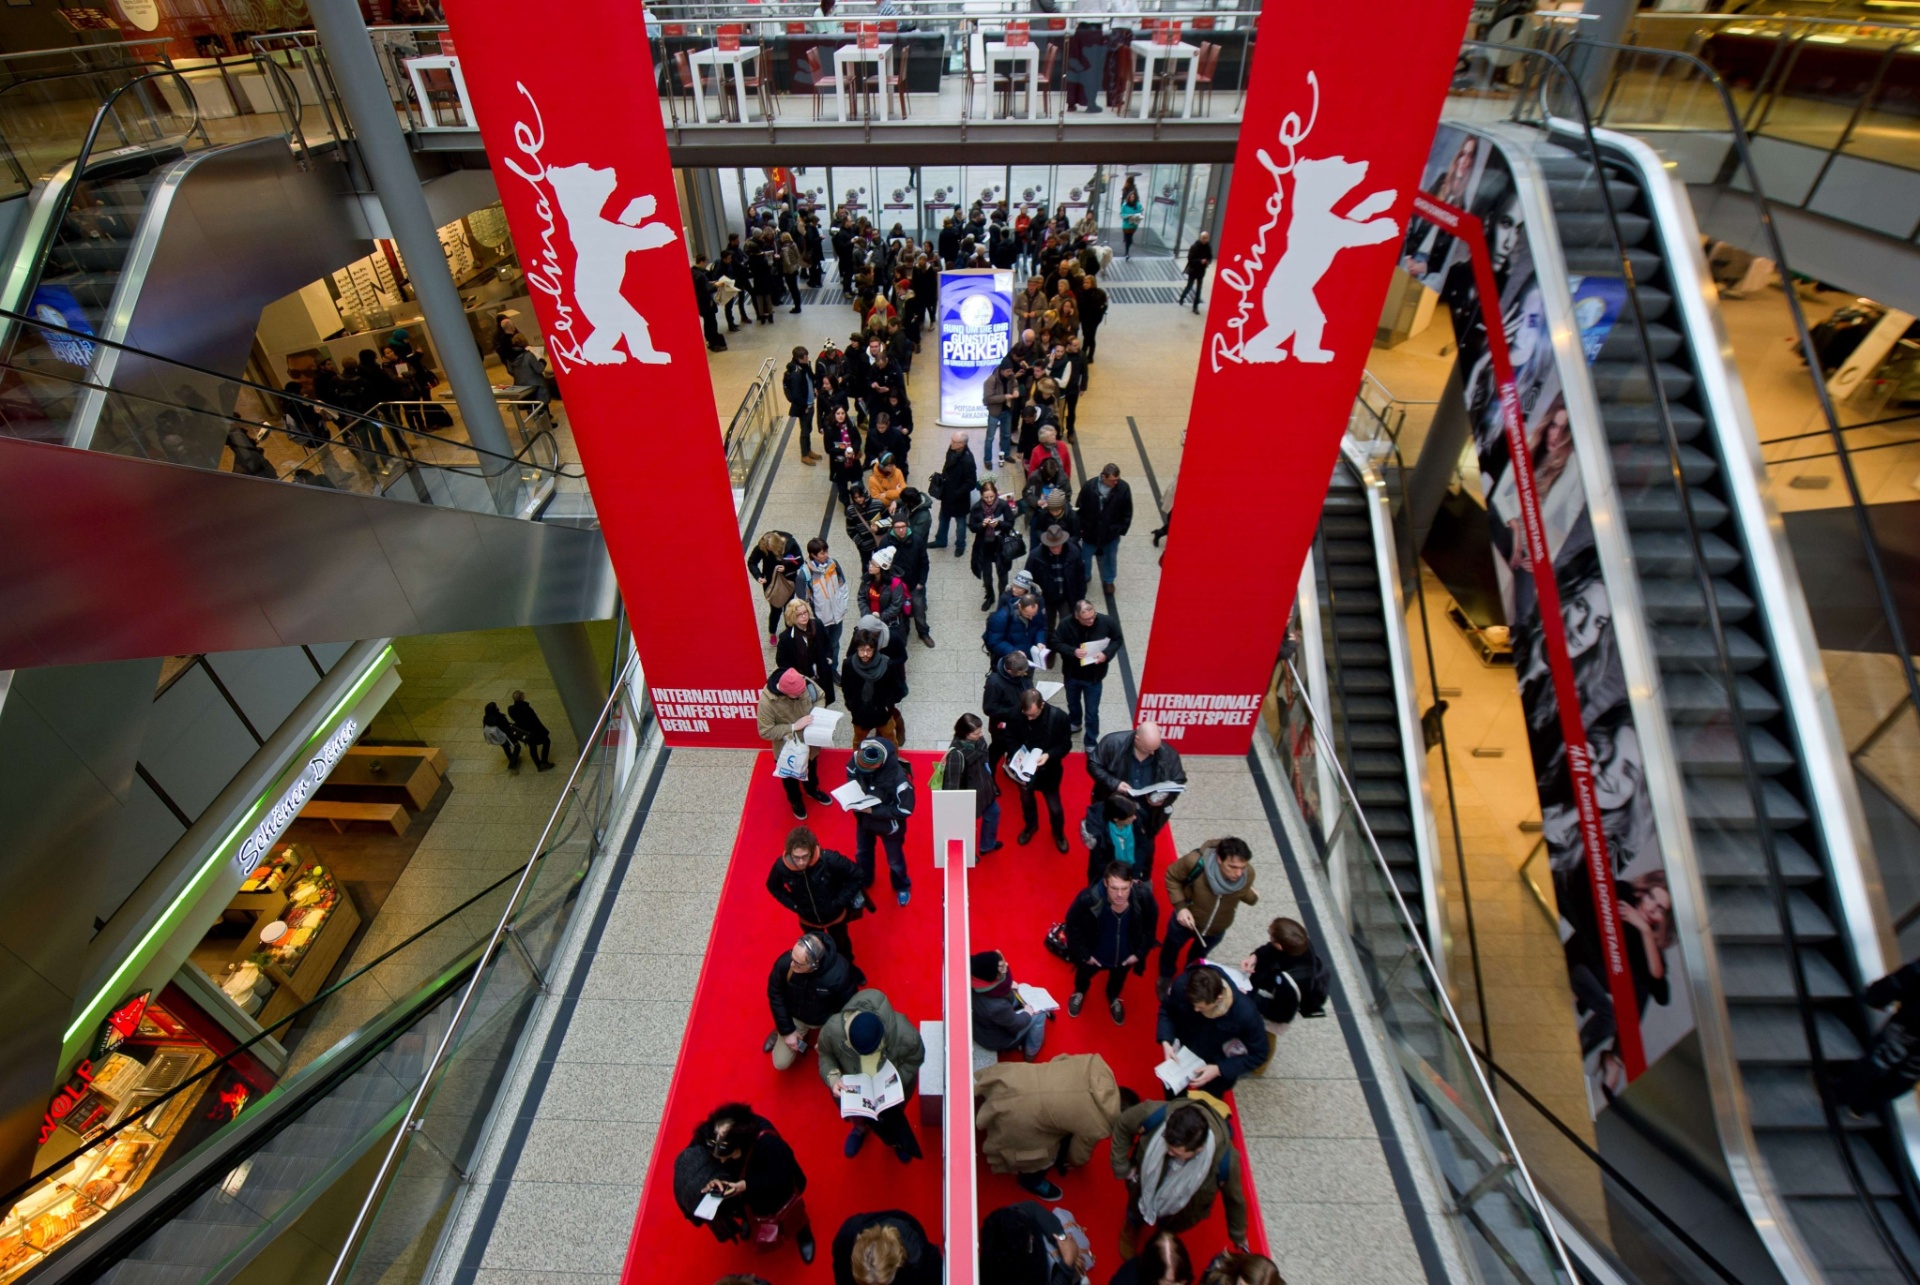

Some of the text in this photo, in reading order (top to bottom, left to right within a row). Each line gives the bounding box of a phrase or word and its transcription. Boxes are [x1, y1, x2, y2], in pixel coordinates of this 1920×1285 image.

[504, 81, 588, 374] Berlinale
[1212, 70, 1319, 373] Berlinale
[943, 340, 1008, 360] PARKEN
[1514, 442, 1530, 490] FASHION
[660, 719, 710, 732] BERLIN
[1137, 710, 1253, 725] FILMFESTSPIELE
[1141, 694, 1261, 709] INTERNATIONALE
[237, 780, 310, 875] Schöner
[309, 720, 357, 782] Döner
[1577, 777, 1593, 822] LADIES
[1586, 821, 1607, 881] FASHION
